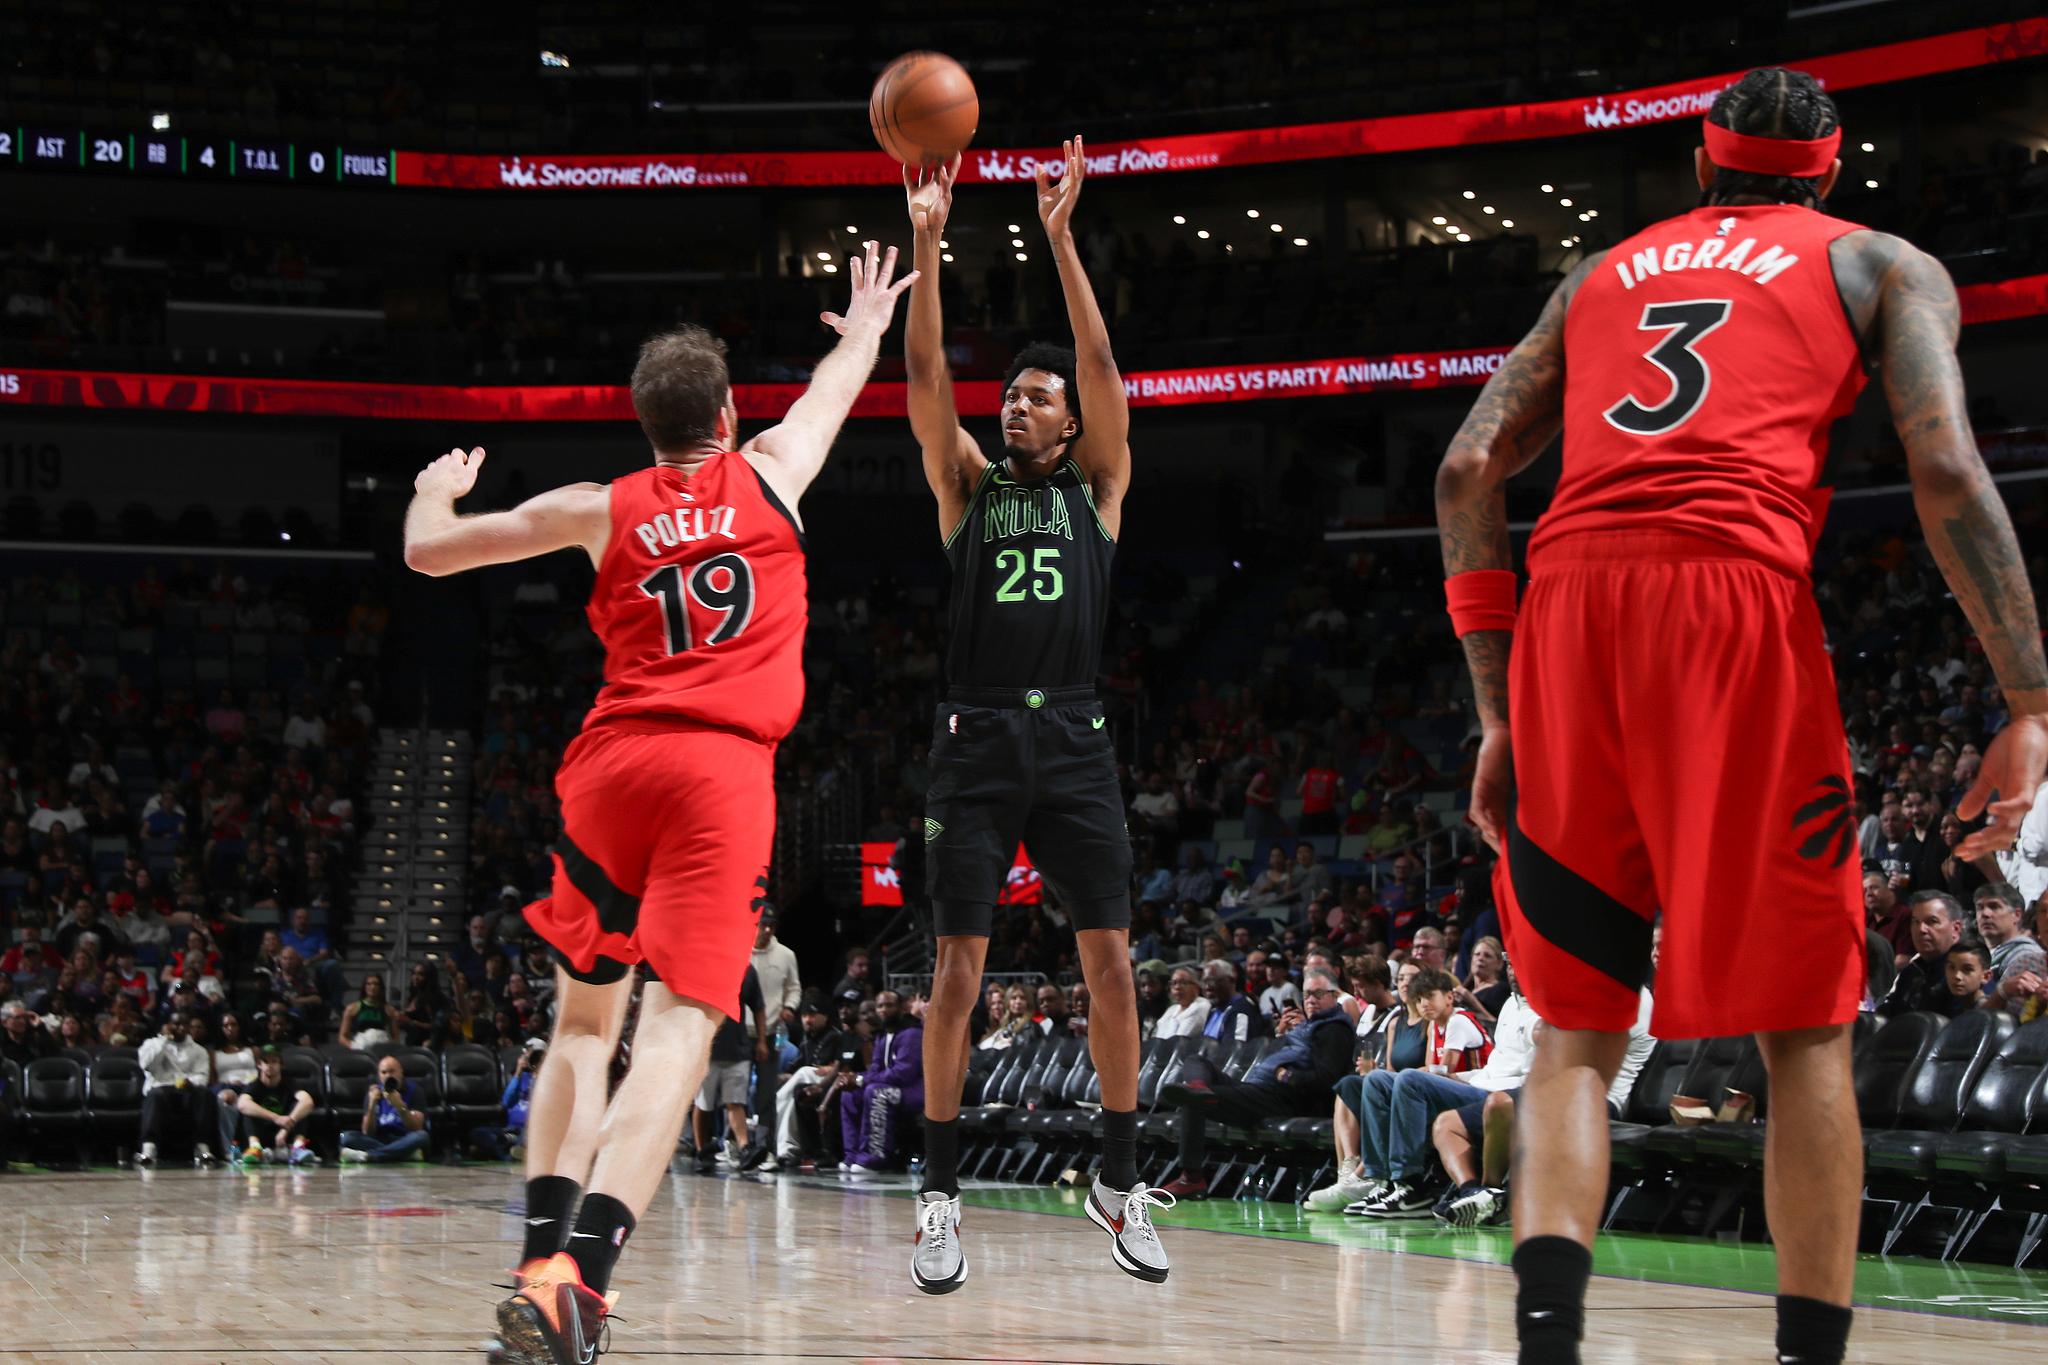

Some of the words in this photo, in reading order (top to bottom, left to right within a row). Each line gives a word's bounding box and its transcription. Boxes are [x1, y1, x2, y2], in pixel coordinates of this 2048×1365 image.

[36, 136, 66, 159] AST
[94, 139, 123, 162] 20
[200, 146, 215, 168] 4
[310, 152, 325, 174] 0
[344, 154, 387, 177] FOULS
[539, 162, 644, 187] SMOOTHIE
[644, 162, 697, 185] KING
[698, 172, 748, 185] CENTER
[1119, 148, 1169, 172] KING
[1170, 153, 1220, 169] CENTER
[1615, 238, 1799, 289] INGRAM
[1142, 372, 1237, 398] BANANAS
[1239, 370, 1265, 391] VS
[1267, 366, 1332, 388] PARTY
[1334, 359, 1427, 385] ANIMALS
[1602, 299, 1733, 436] 3
[635, 504, 737, 557] POELTL
[983, 487, 1074, 544] NOLA
[995, 548, 1065, 603] 25
[637, 552, 756, 658] 19
